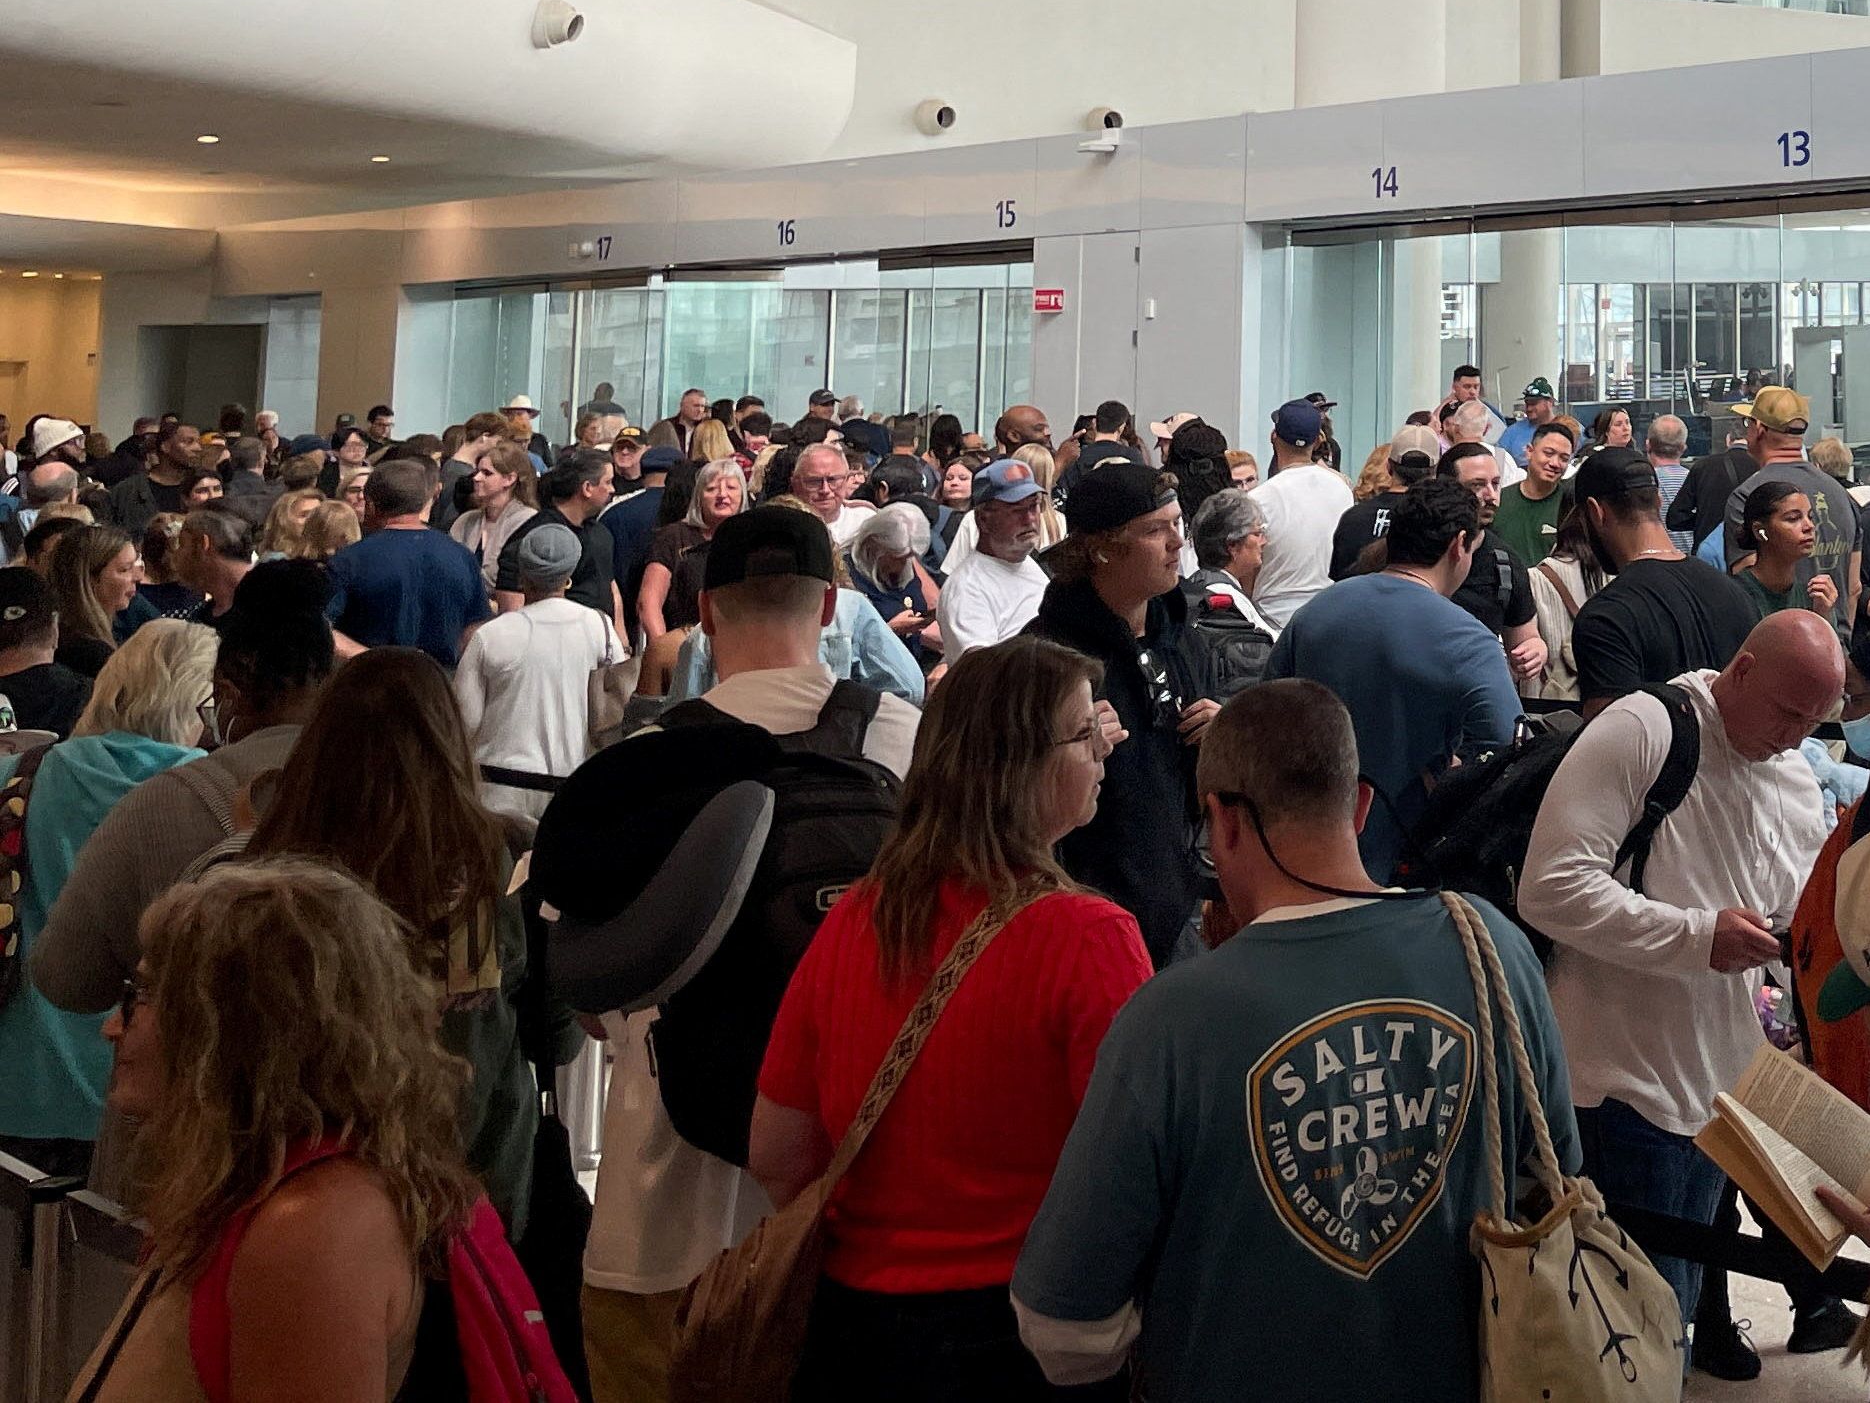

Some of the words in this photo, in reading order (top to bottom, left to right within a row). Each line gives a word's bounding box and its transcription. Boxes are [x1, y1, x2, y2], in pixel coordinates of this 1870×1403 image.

[1777, 130, 1810, 167] 13
[1371, 166, 1399, 198] 14
[995, 200, 1016, 228] 15
[597, 235, 612, 260] 17
[777, 219, 796, 246] 16
[1272, 1021, 1459, 1107] SALTY
[1297, 1087, 1436, 1152] CREW
[1268, 1120, 1299, 1183] FIND
[1292, 1182, 1361, 1252] REFUGE
[1369, 1212, 1398, 1245] IN
[1400, 1150, 1442, 1204] THE
[1437, 1082, 1461, 1138] SEA
